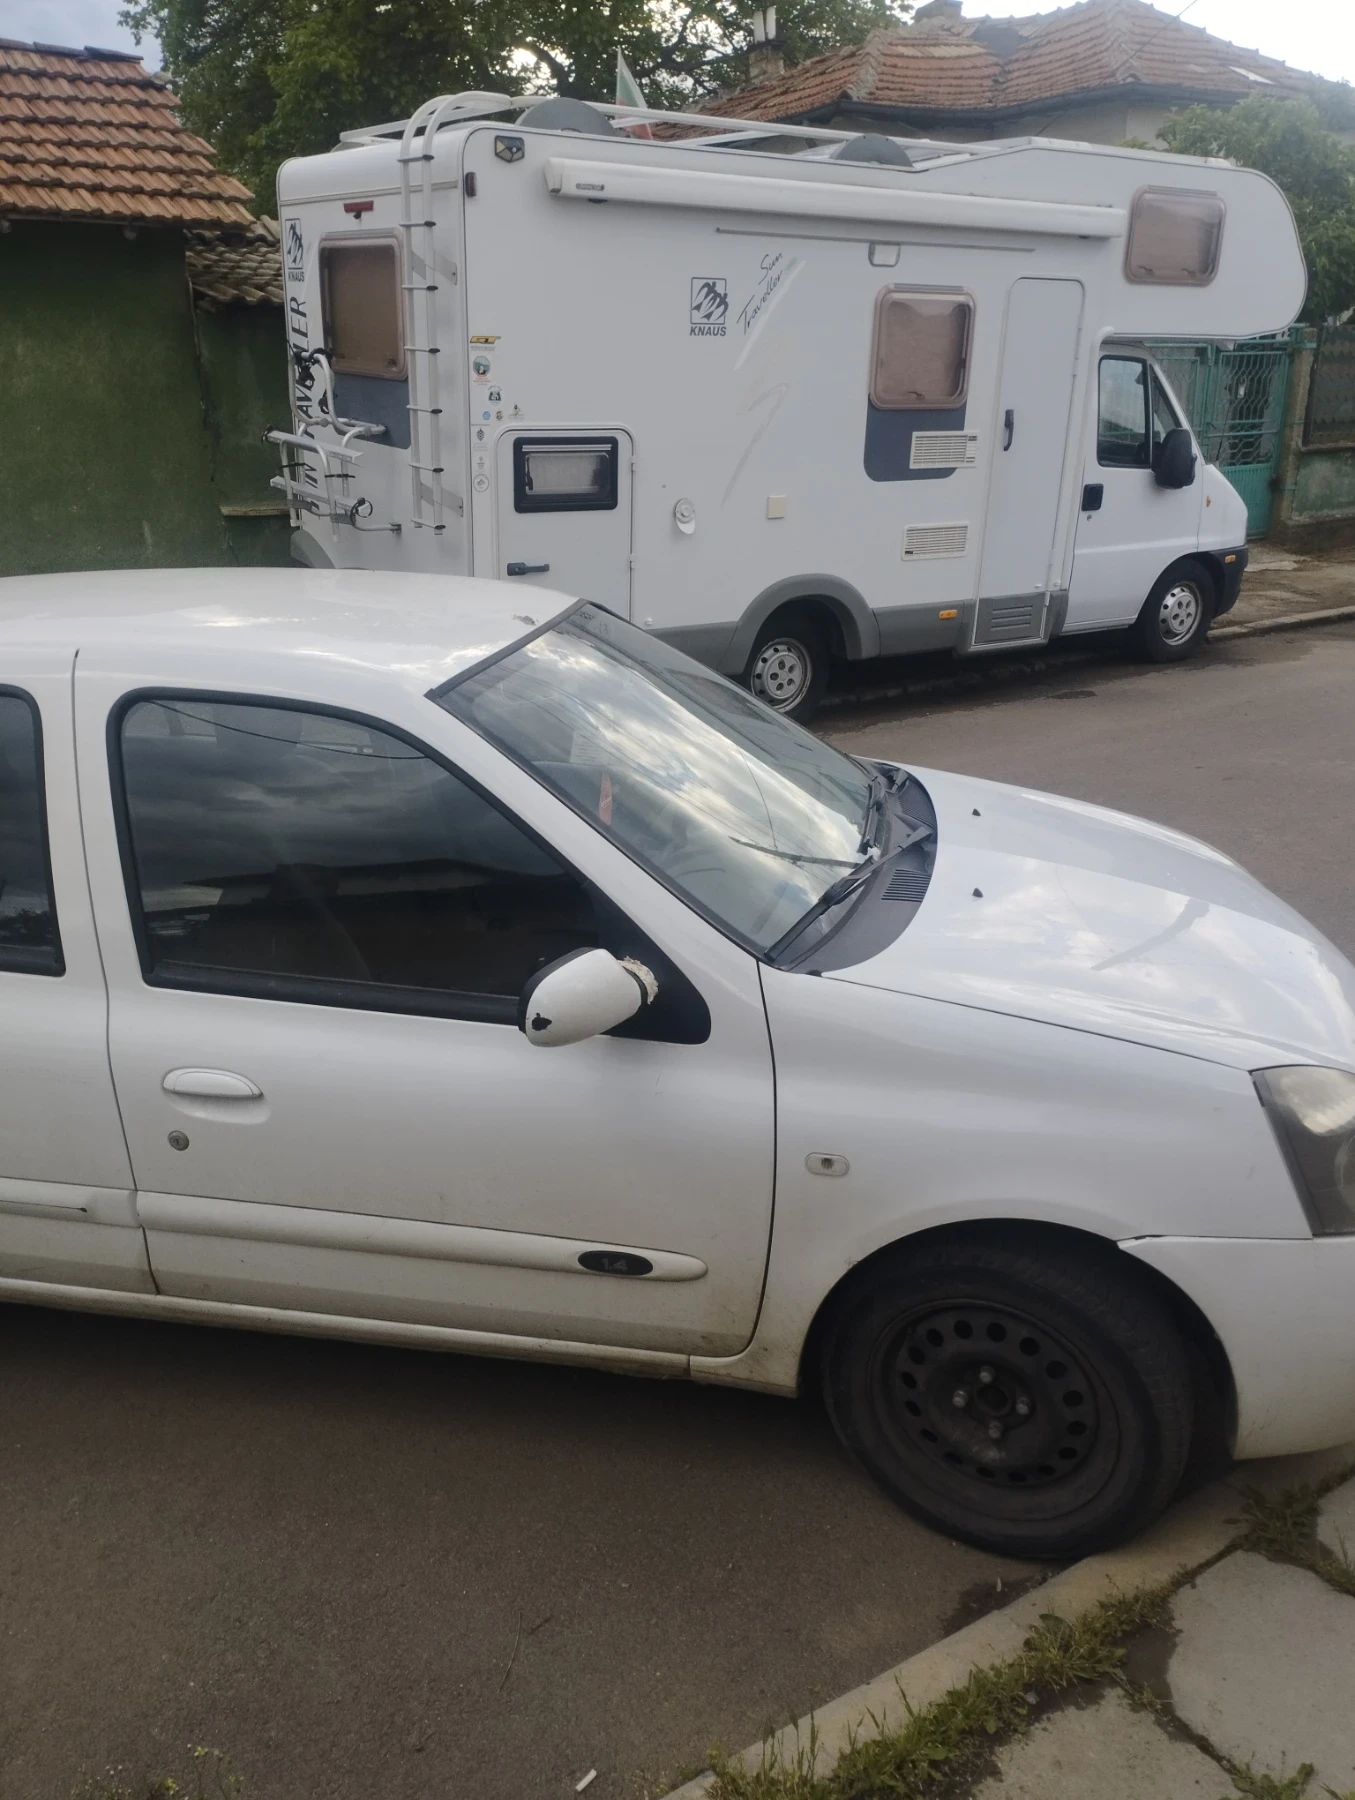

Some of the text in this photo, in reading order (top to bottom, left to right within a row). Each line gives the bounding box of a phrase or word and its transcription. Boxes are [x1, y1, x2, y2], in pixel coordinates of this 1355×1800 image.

[288, 271, 305, 282] KNAUS
[758, 252, 783, 285] Sun
[736, 269, 783, 335] Traveller
[690, 325, 727, 337] KNAUS
